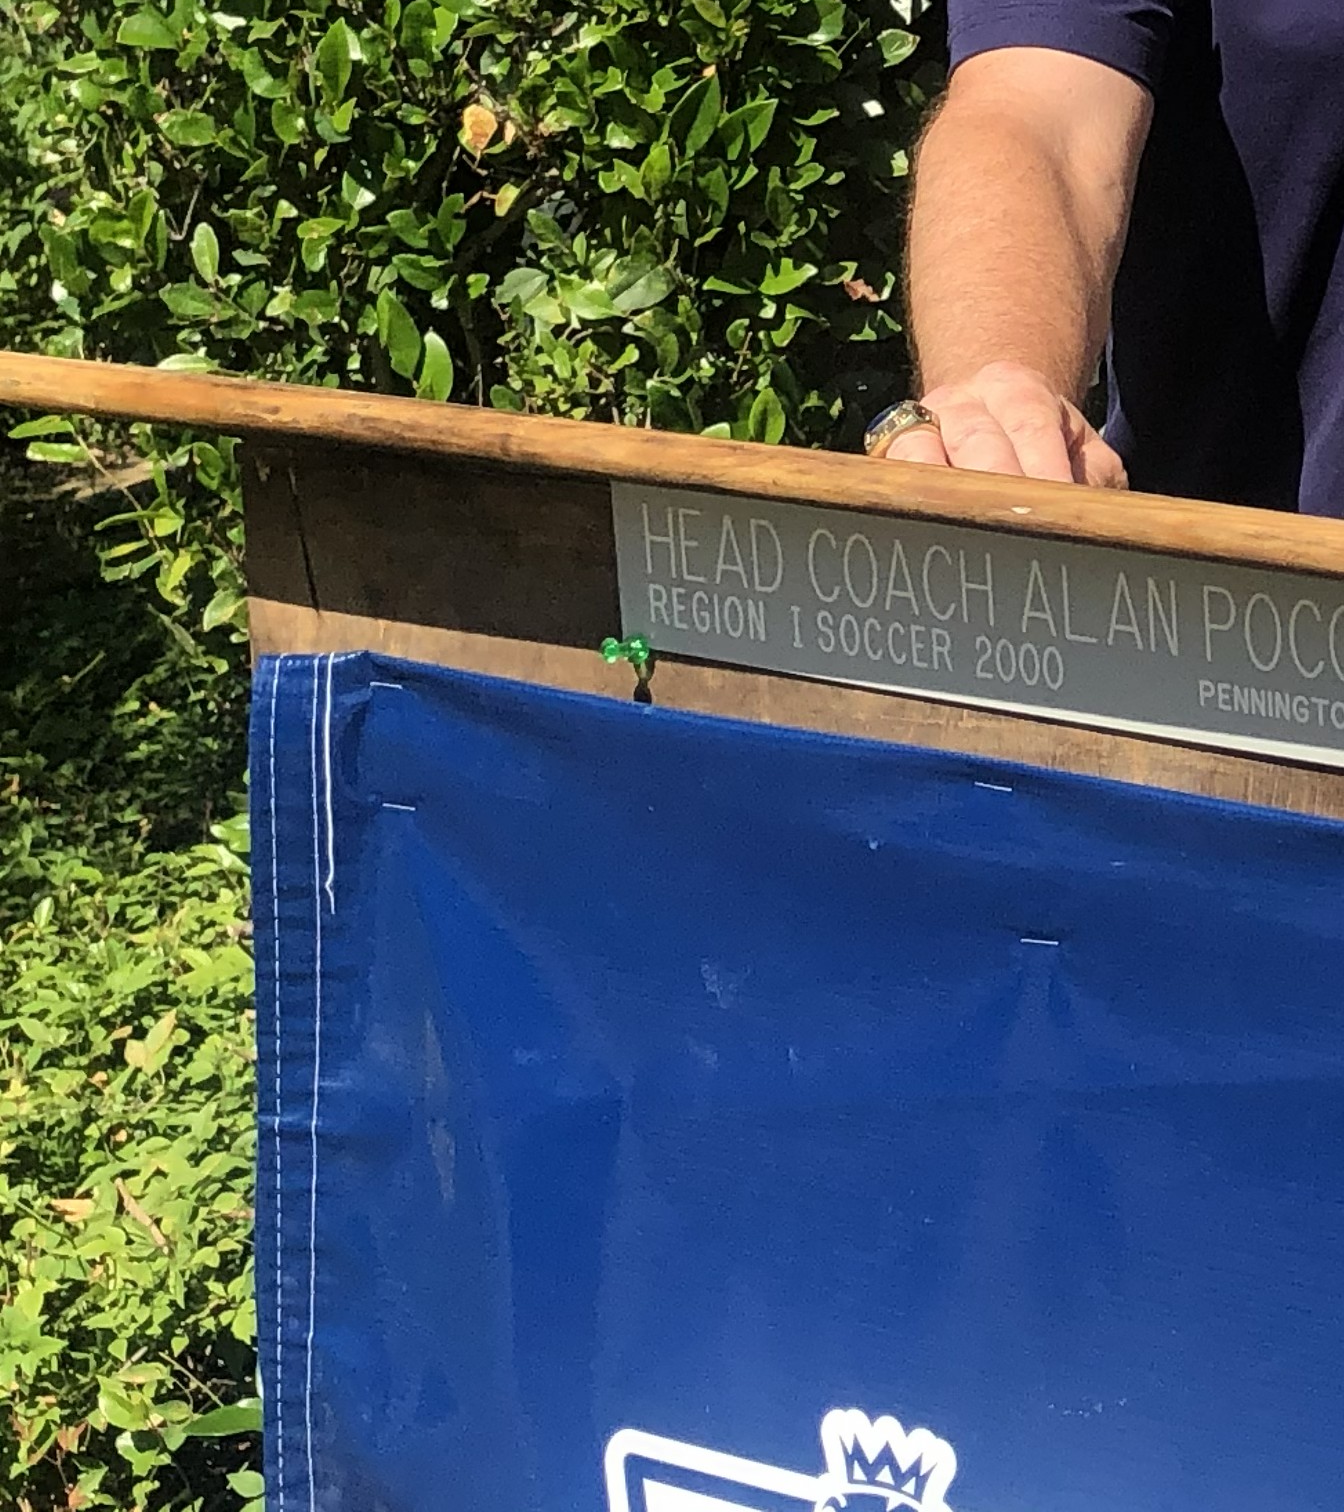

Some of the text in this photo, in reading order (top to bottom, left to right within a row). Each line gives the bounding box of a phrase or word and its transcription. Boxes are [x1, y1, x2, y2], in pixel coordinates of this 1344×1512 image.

[642, 503, 784, 594] HEAD
[807, 528, 995, 626] COACH
[1020, 559, 1179, 657] ALAN
[648, 583, 766, 642] REGION
[816, 609, 954, 672] SOCCER
[975, 635, 1064, 690] 2000
